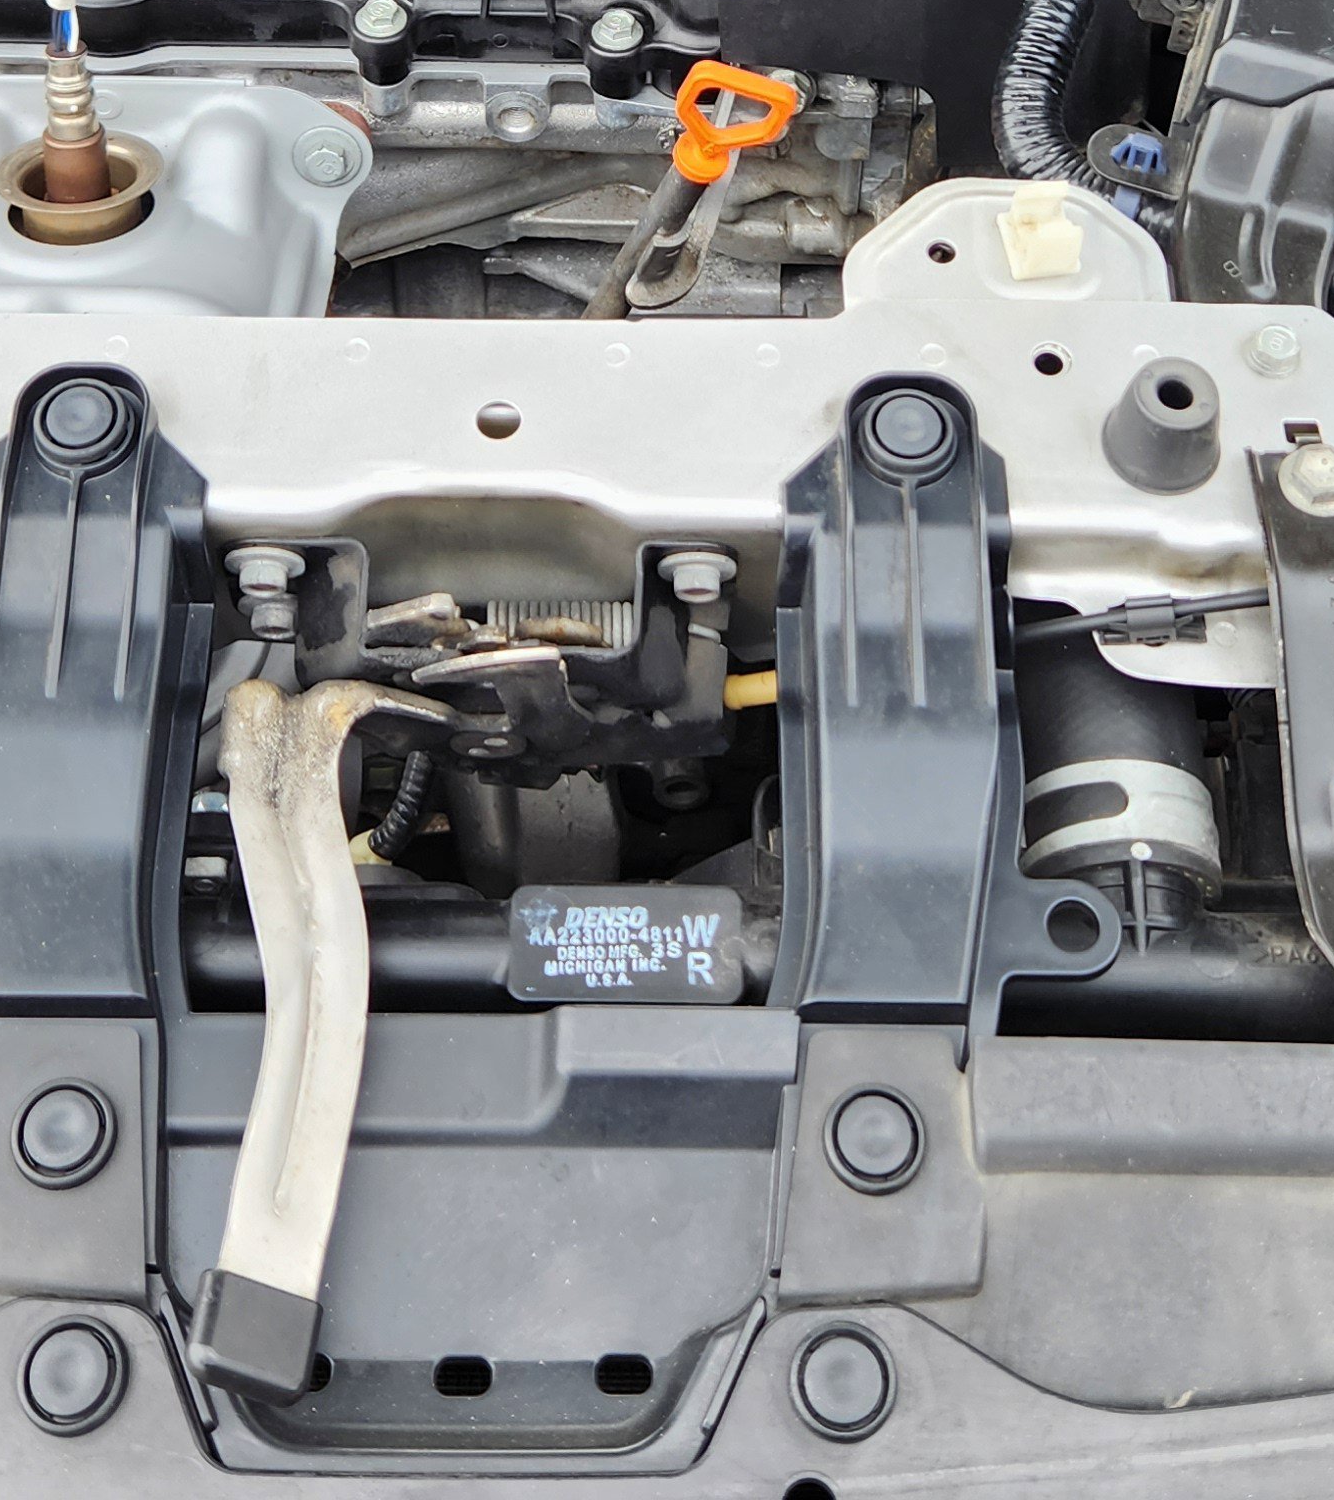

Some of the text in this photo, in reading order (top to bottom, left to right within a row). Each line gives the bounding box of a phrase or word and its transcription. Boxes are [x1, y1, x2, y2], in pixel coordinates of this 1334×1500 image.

[564, 905, 650, 930] DENSO
[681, 912, 721, 949] W
[556, 945, 606, 961] DENSO
[608, 943, 643, 960] MFG.
[544, 958, 667, 977] MICHIGAN INC.
[686, 951, 716, 986] R
[585, 972, 635, 988] U.S.A.
